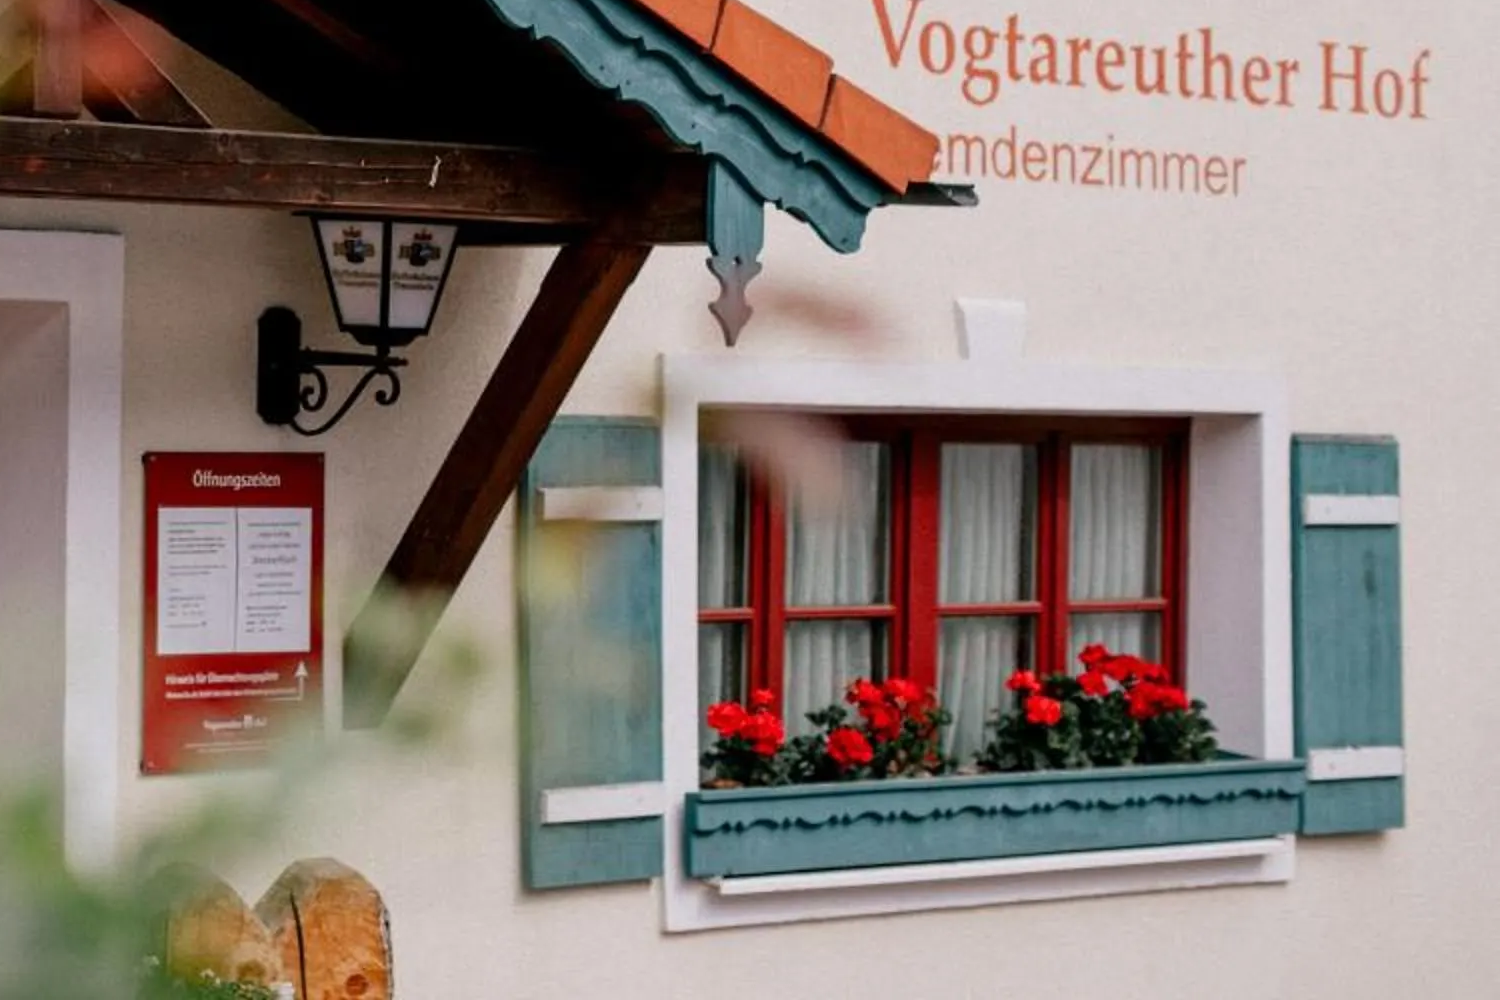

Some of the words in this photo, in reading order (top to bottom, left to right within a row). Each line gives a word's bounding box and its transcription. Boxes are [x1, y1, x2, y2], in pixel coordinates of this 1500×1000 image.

[1317, 40, 1432, 120] Hof
[933, 125, 1247, 197] mdenzimmer
[192, 469, 281, 491] Öffnungszeiten
